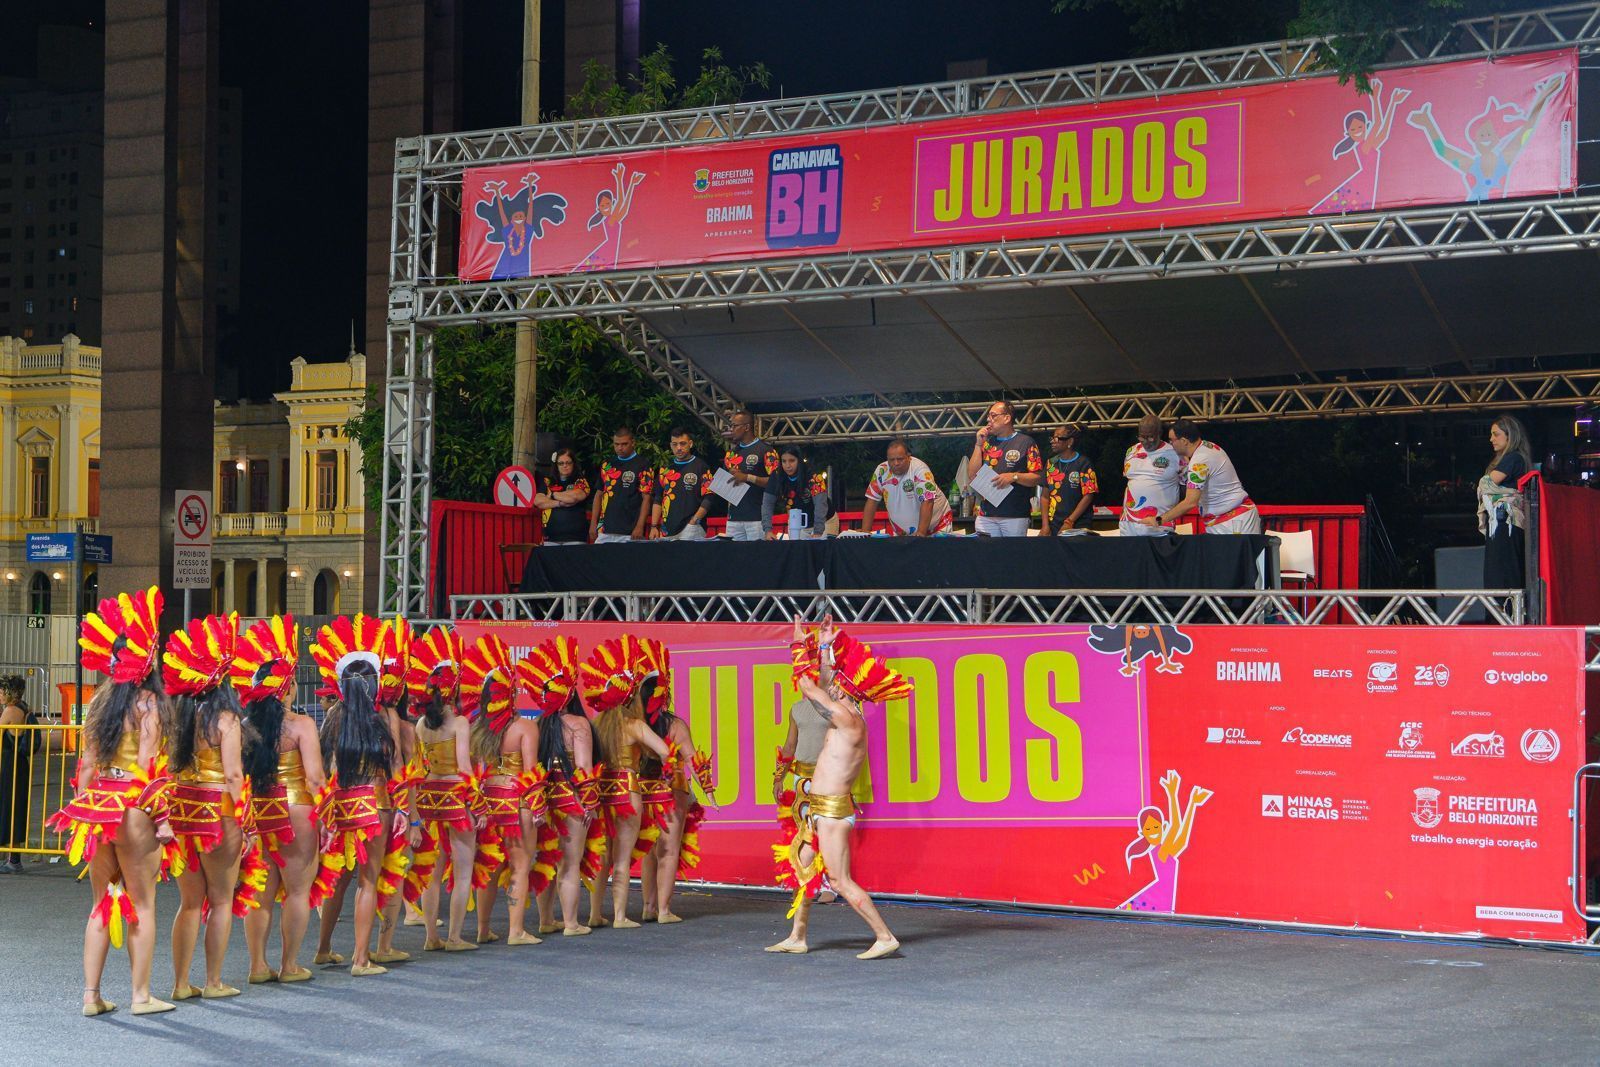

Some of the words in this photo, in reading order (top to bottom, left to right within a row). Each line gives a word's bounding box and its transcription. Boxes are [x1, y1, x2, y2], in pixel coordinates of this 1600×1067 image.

[773, 148, 839, 171] CARNAVAL
[712, 169, 754, 180] PREFEITURA
[933, 116, 1208, 222] JURADOS
[712, 179, 725, 187] BELO
[725, 177, 754, 186] HORIZONTE
[769, 169, 839, 238] BH
[706, 204, 753, 223] BRAHMA
[704, 229, 753, 238] APRESENTAM
[533, 620, 559, 629] coração
[1216, 661, 1282, 682] BRAHMA
[1313, 670, 1353, 678] BEATS
[1414, 666, 1434, 680] Zé
[1500, 670, 1548, 684] tvglobo
[1366, 681, 1398, 694] Guaraná
[1225, 728, 1246, 738] CDL
[1300, 734, 1352, 744] CODEMGE
[1287, 796, 1332, 808] MINAS
[1448, 796, 1538, 814] PREFEITURA
[1287, 808, 1340, 820] GERAIS
[1448, 812, 1476, 824] BELO
[1478, 814, 1538, 826] HORIZONTE
[1410, 834, 1454, 844] trabalho
[1456, 837, 1494, 848] energia
[1497, 838, 1538, 850] coração
